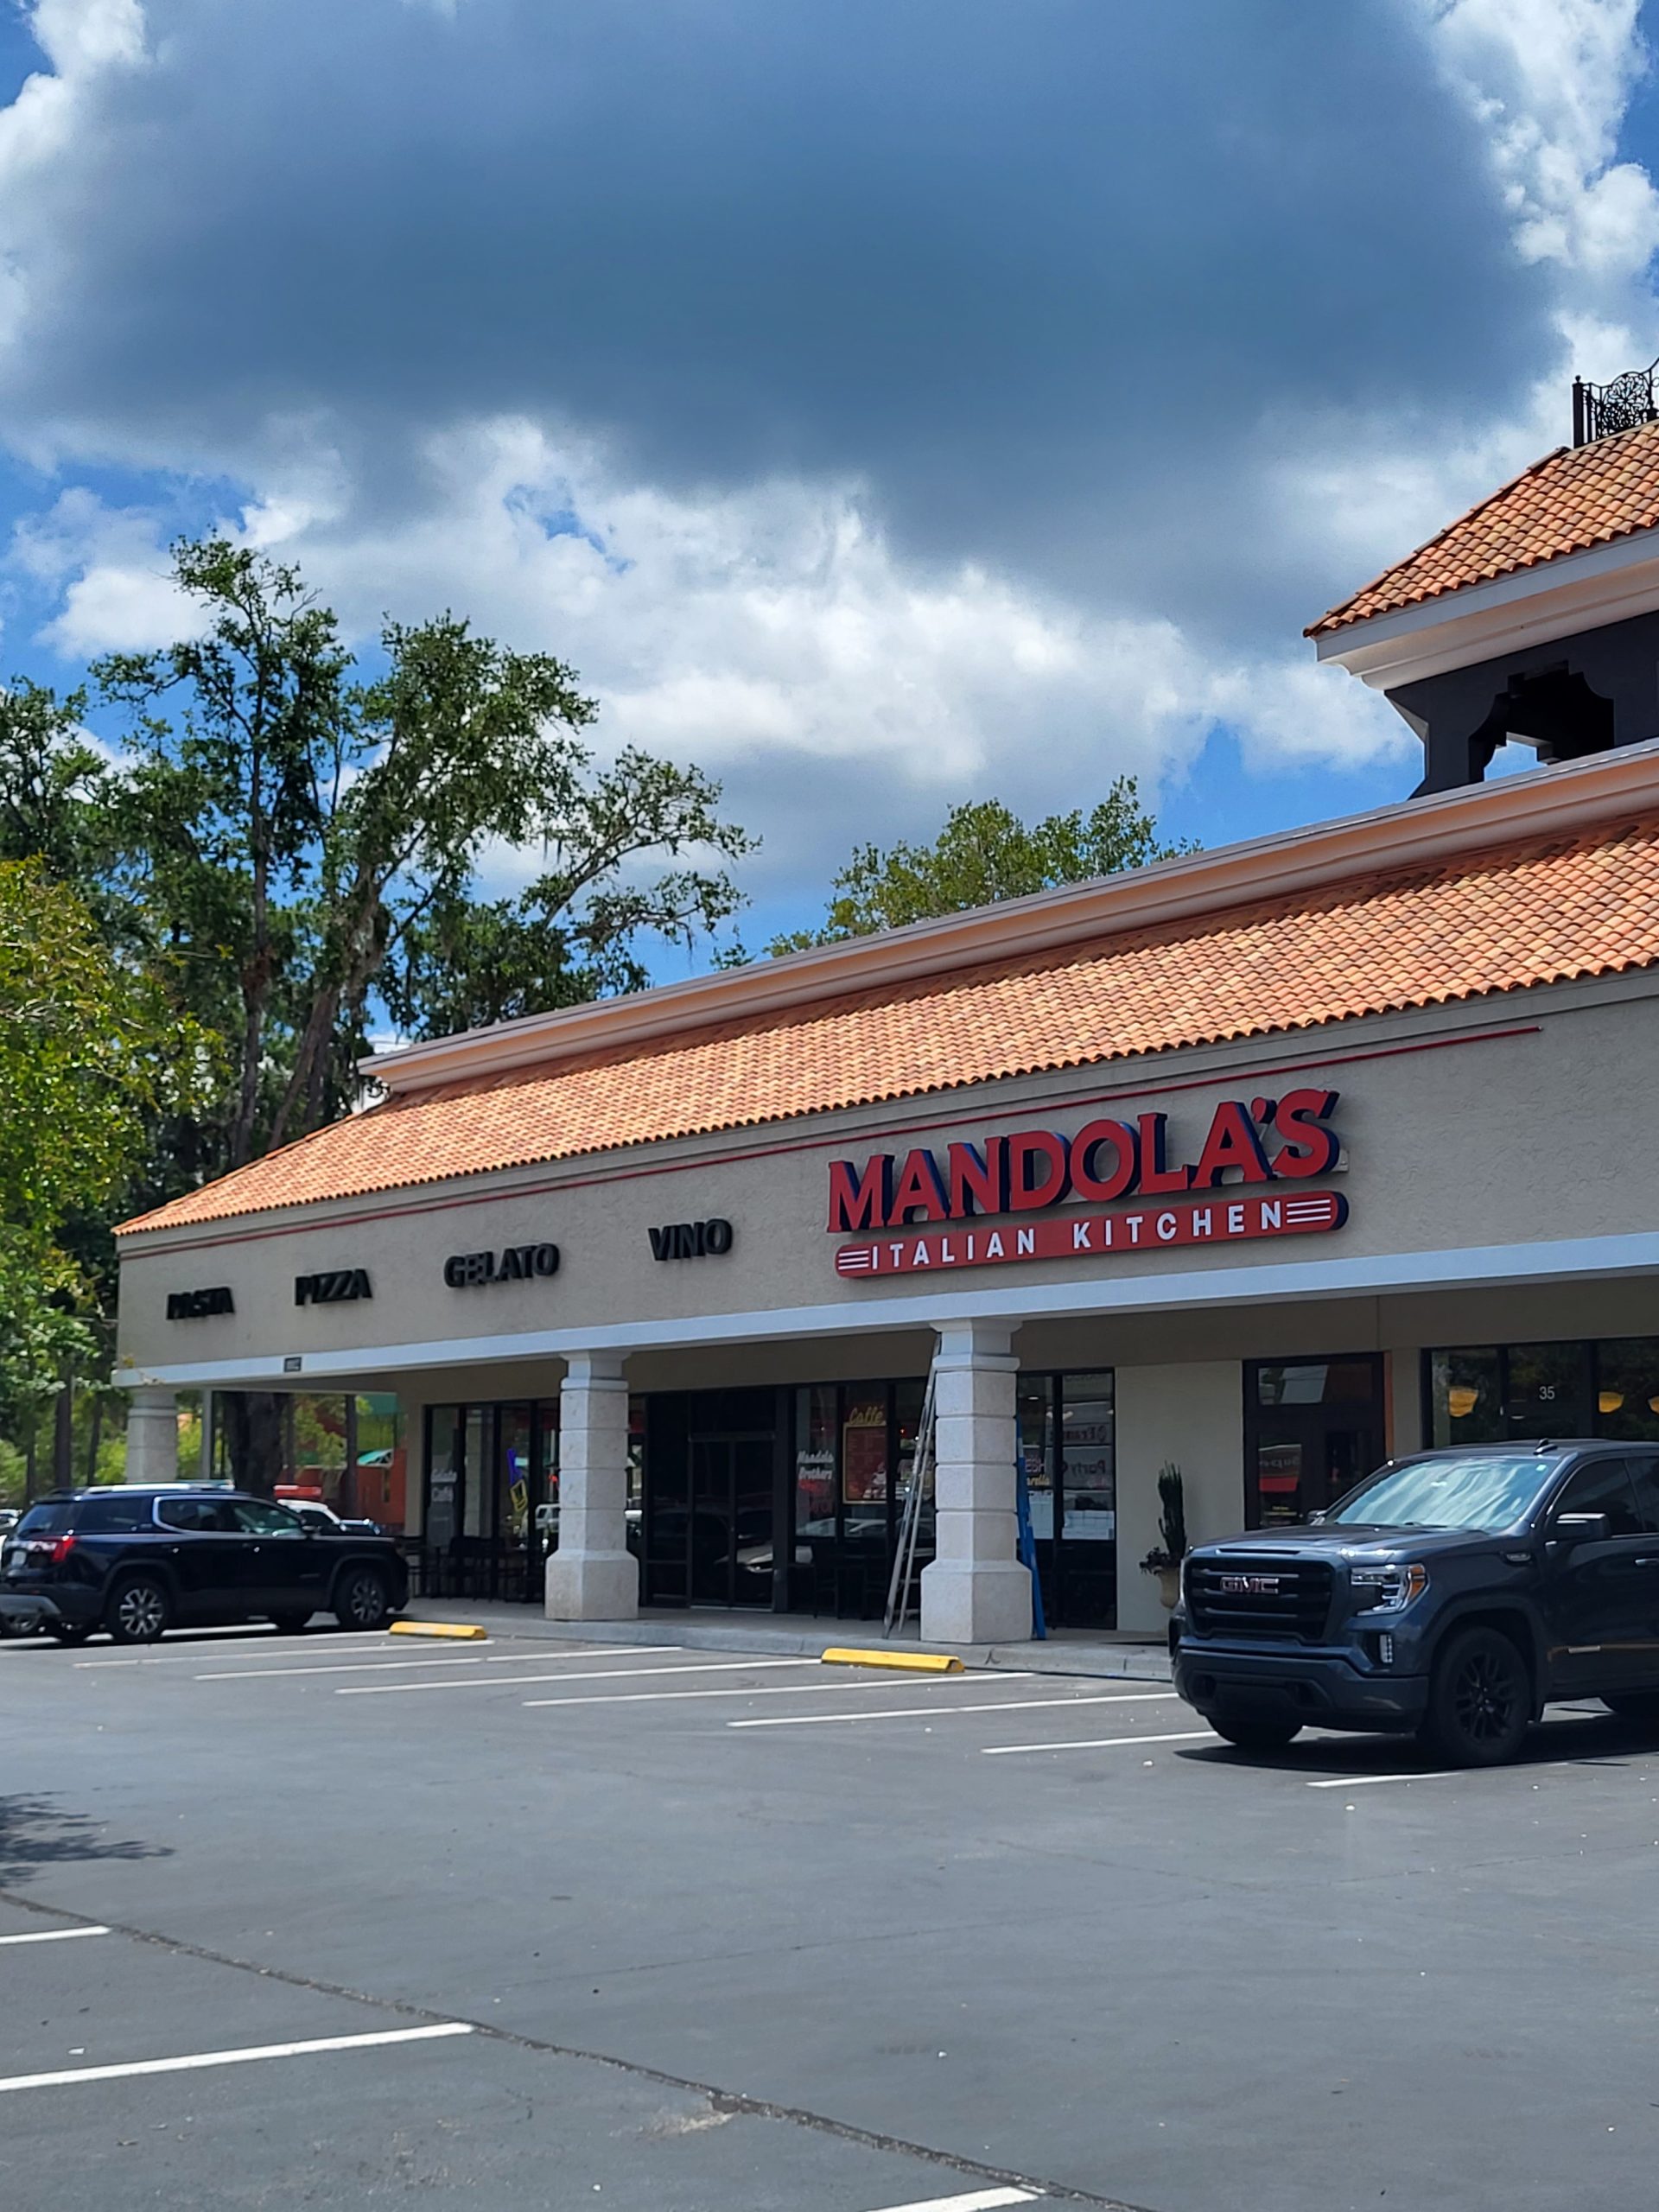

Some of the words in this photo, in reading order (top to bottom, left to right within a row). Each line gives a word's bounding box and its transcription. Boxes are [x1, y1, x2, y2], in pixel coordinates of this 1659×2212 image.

[827, 1088, 1339, 1233] MANDOLA'S
[648, 1218, 733, 1261] VINO
[872, 1228, 1035, 1270] ITALIAN
[1072, 1200, 1281, 1249] KITCHEN
[444, 1243, 560, 1287] GELATO
[295, 1268, 372, 1306] PIZZA
[1539, 1386, 1555, 1400] 35
[1220, 1576, 1280, 1594] GMC
